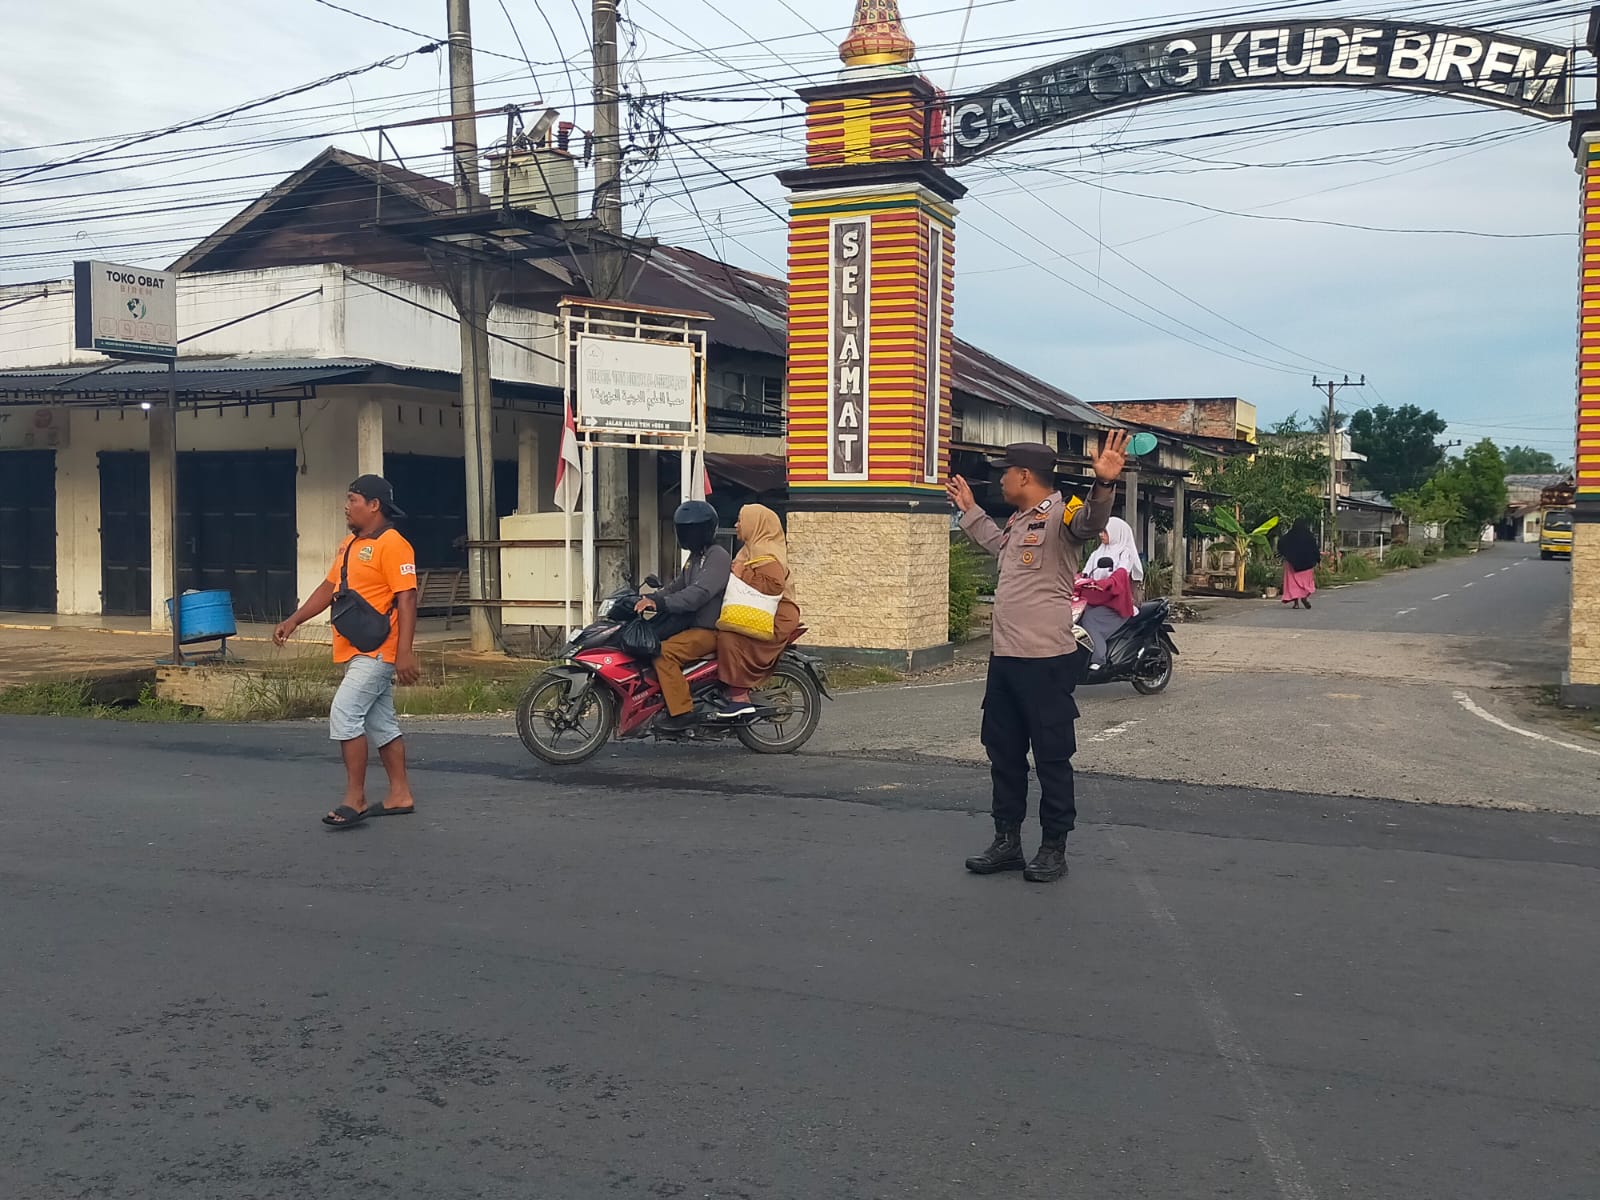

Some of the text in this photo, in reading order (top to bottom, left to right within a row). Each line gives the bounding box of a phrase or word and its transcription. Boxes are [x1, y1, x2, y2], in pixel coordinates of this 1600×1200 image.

[1209, 27, 1383, 81] KEUDE
[1387, 29, 1568, 104] BIREM
[106, 270, 165, 289] TOKO OBAT
[837, 229, 861, 462] SELAMAT
